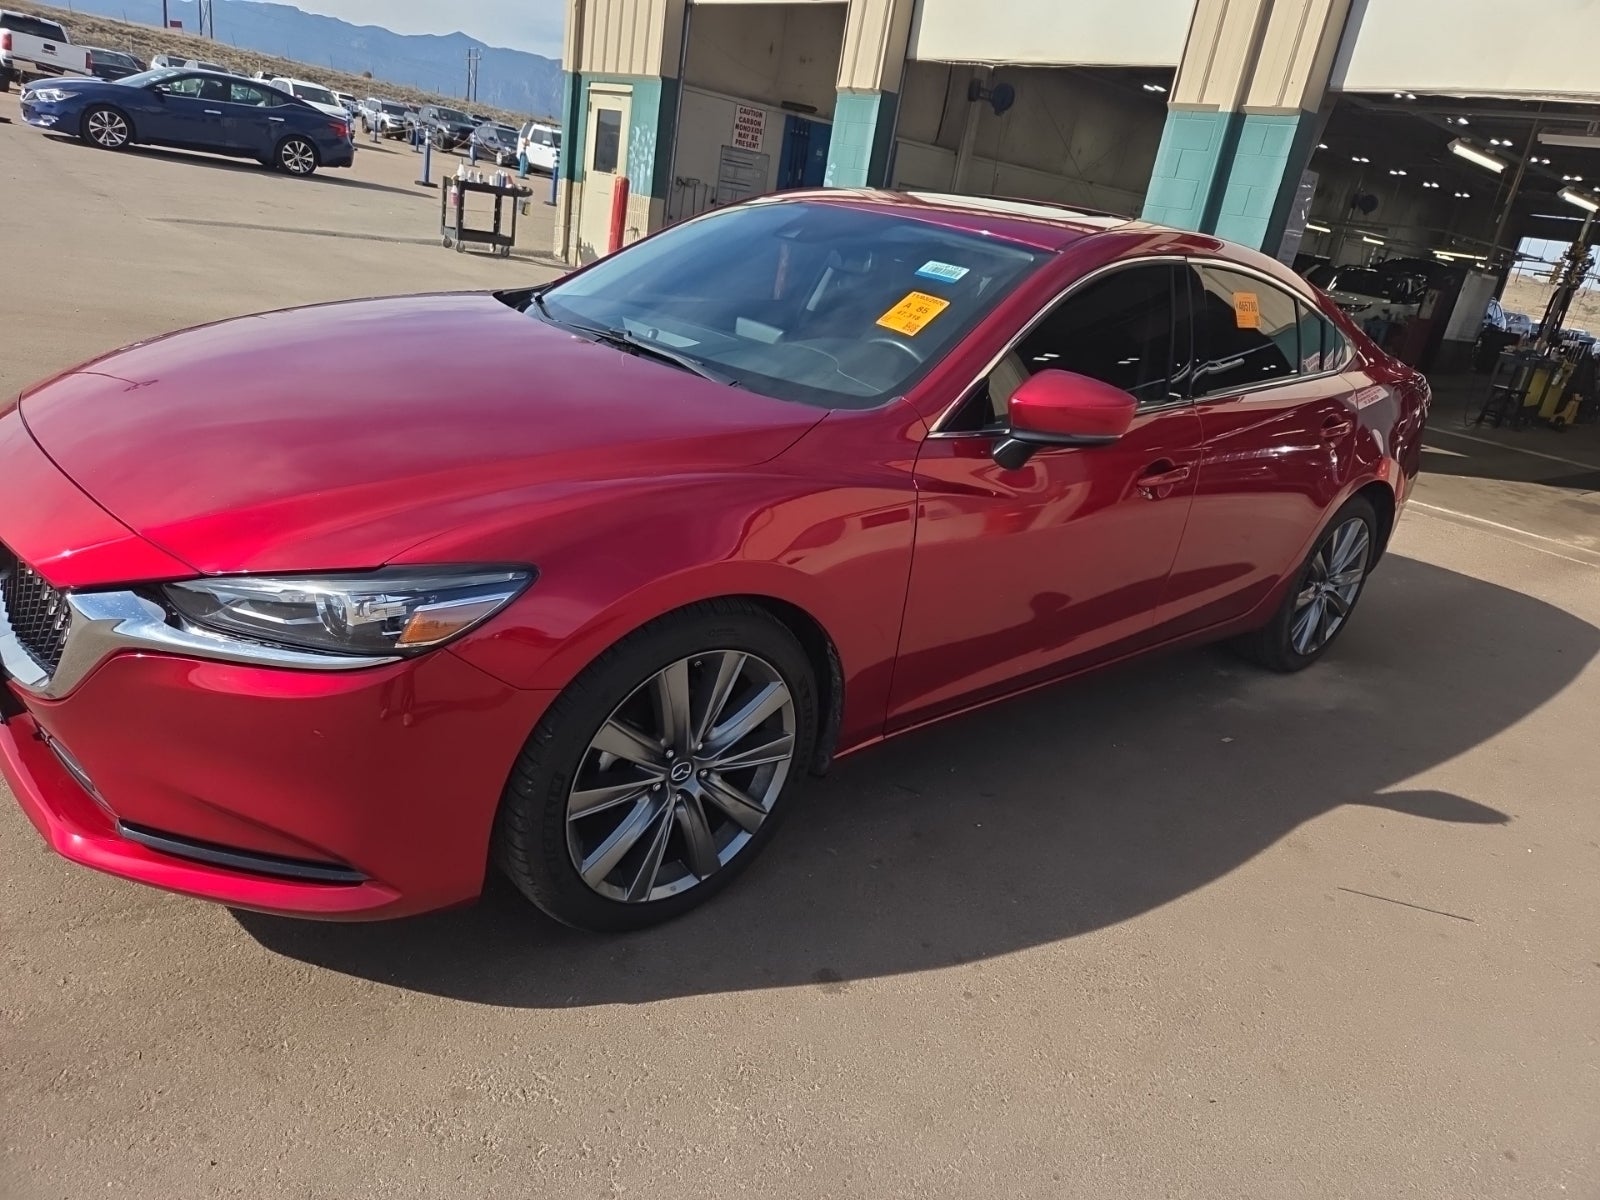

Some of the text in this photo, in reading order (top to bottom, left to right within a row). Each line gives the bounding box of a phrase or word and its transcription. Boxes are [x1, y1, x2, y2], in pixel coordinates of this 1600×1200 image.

[739, 107, 763, 119] CAUTION
[738, 117, 762, 127] CARBON
[735, 124, 763, 135] MONOXIDE
[738, 131, 759, 142] MAY BE
[735, 138, 760, 149] PRESENT
[916, 306, 929, 314] 85
